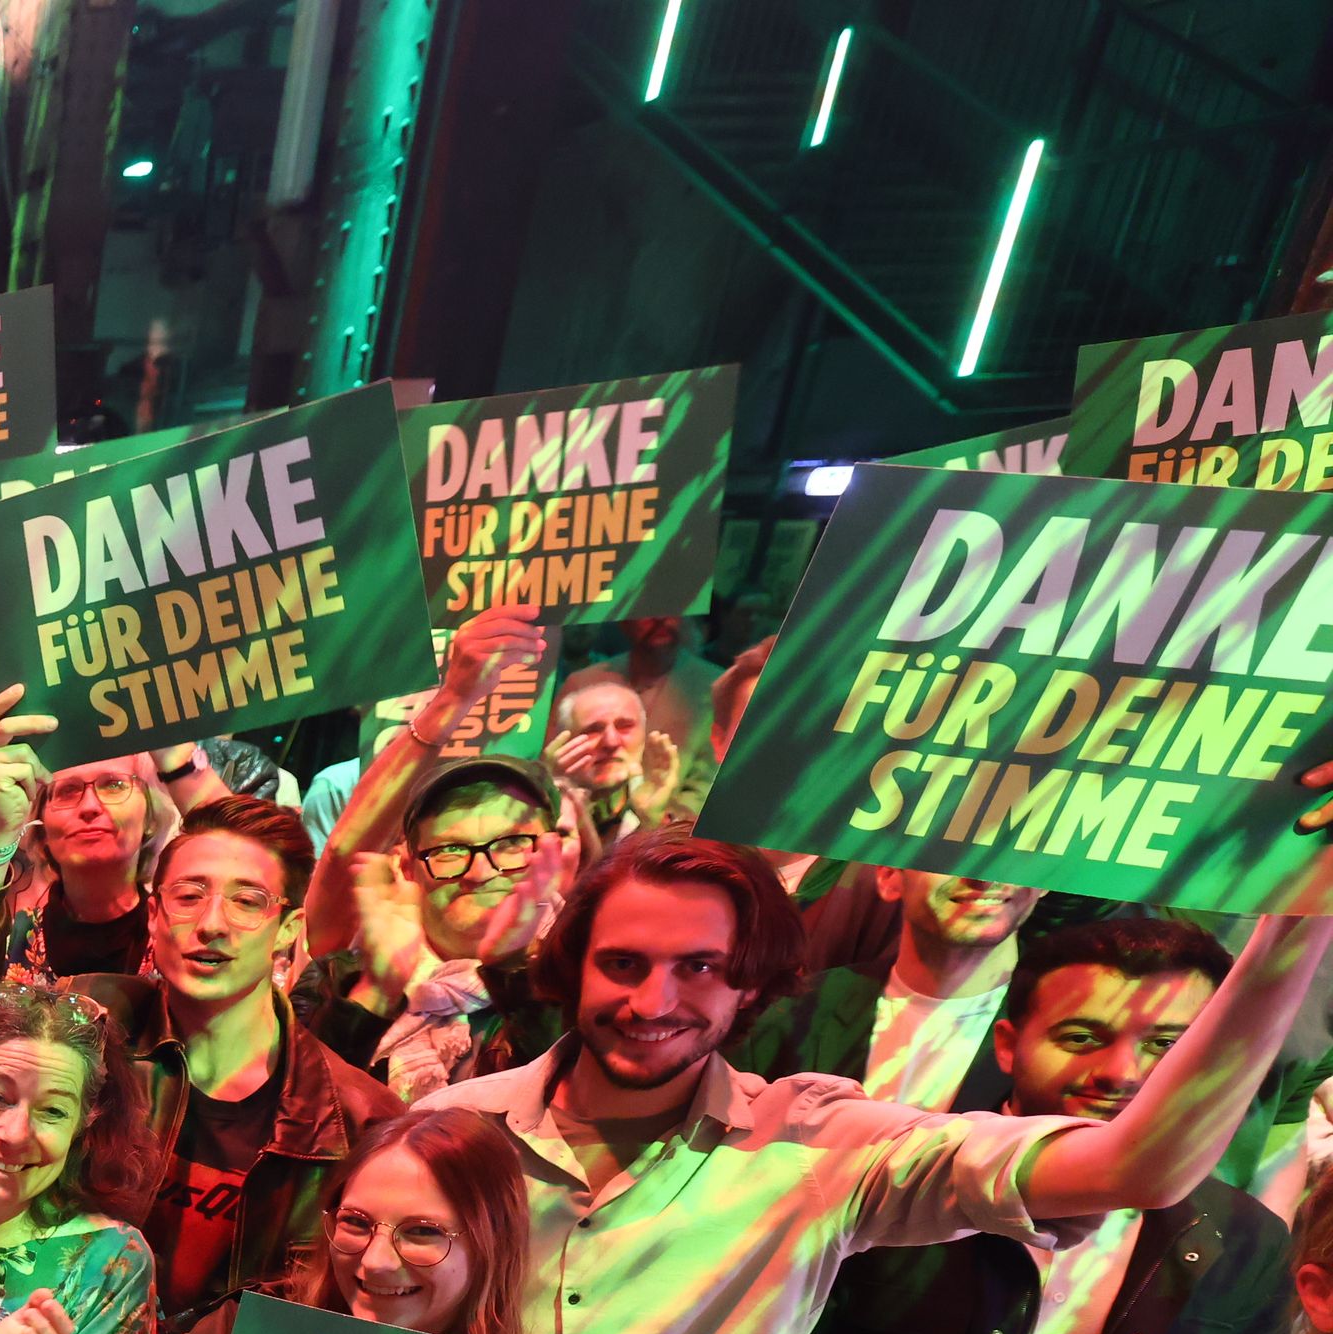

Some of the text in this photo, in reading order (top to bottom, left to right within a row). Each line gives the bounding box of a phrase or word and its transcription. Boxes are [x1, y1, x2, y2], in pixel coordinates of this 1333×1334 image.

[425, 397, 664, 503] DANKE
[22, 436, 325, 618] DANKE
[423, 488, 656, 558] FÜR DEINE
[446, 550, 615, 611] STIMME
[36, 546, 345, 688] FÜR DEINE
[876, 508, 1333, 683] DANKE
[89, 628, 314, 738] STIMME
[834, 651, 1325, 782] FÜR DEINE
[849, 751, 1201, 870] STIMME
